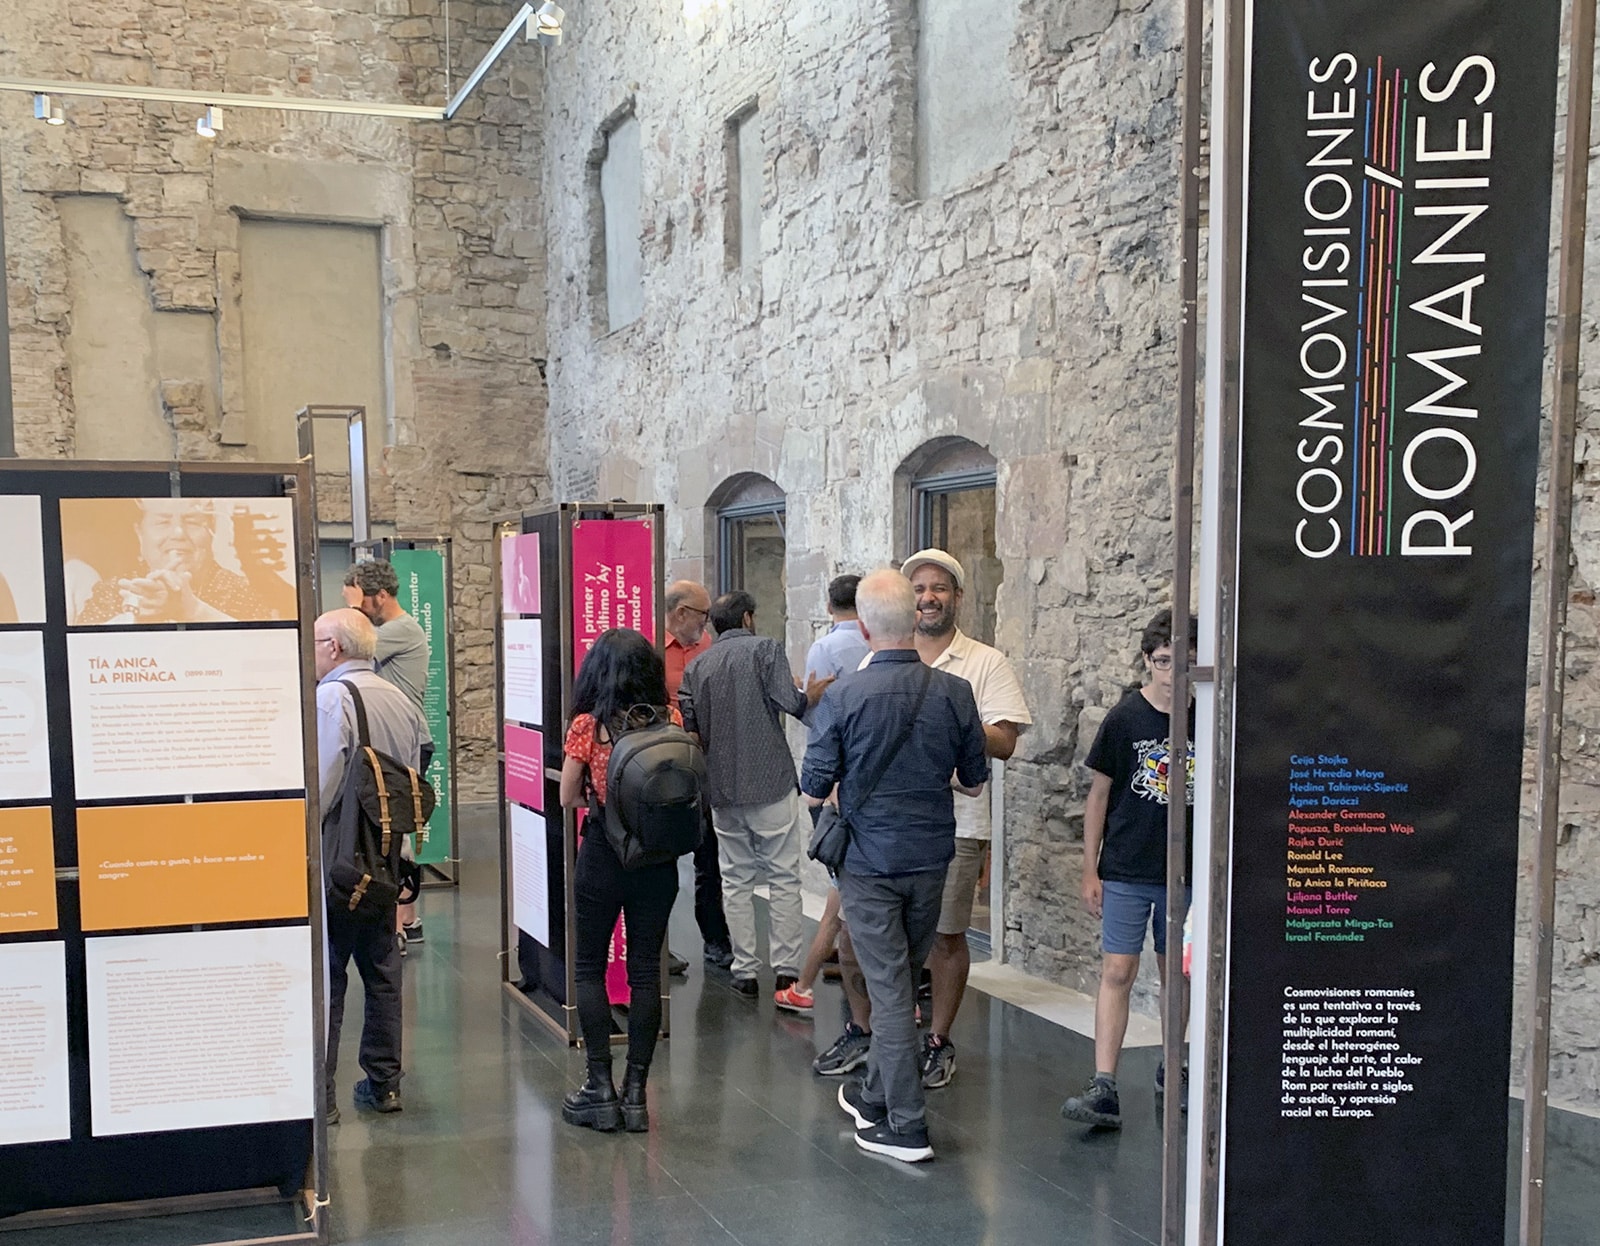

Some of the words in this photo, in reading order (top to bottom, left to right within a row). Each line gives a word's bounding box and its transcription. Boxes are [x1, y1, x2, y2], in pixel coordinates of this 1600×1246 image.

[1295, 52, 1358, 559] COSMOVISIONES
[585, 573, 595, 582] y
[616, 565, 627, 598] para
[583, 587, 597, 633] primer
[597, 589, 609, 631] último
[628, 586, 640, 630] madre
[616, 605, 625, 629] ron
[581, 639, 594, 650] el
[89, 656, 109, 669] TÍA
[114, 658, 157, 668] ANICA
[90, 673, 107, 683] LA
[113, 669, 176, 683] PIRIÑACA
[433, 760, 445, 770] el
[1290, 755, 1314, 766] Ceija
[1318, 755, 1348, 767] Stojka
[1289, 769, 1309, 780] José
[1313, 769, 1352, 779] Heredia
[1356, 770, 1384, 780] Maya
[431, 775, 445, 807] poder
[1289, 783, 1324, 792] Hedina
[1288, 810, 1337, 819] Alexander
[1340, 810, 1385, 819] Germano
[1390, 825, 1415, 835] Wajs
[1288, 838, 1315, 848] Rajko
[1287, 851, 1321, 860] Ronald
[1325, 852, 1343, 860] Lee
[1287, 864, 1325, 874] Manush
[1329, 865, 1374, 874] Romanov
[1304, 878, 1332, 887] Anica
[1335, 878, 1344, 887] la
[1347, 879, 1387, 888] Piriñaca
[1325, 892, 1358, 901] Buttler
[1286, 906, 1322, 914] Manuel
[1326, 906, 1350, 914] Torre
[1344, 919, 1393, 930] Mirga-Tas
[1286, 932, 1312, 941] Israel
[1315, 933, 1364, 942] Fernández
[1284, 987, 1361, 997] Cosmovisiones
[1364, 988, 1415, 997] romaníes
[1283, 1002, 1295, 1010] es
[1299, 1002, 1319, 1010] una
[1324, 1001, 1372, 1010] tentativa
[1375, 1002, 1383, 1010] a
[1388, 1001, 1421, 1011] través
[1283, 1013, 1297, 1023] de
[1301, 1013, 1311, 1023] la
[1315, 1016, 1335, 1025] que
[1339, 1013, 1384, 1025] explorar
[1388, 1013, 1398, 1023] la
[1283, 1027, 1352, 1039] multiplicidad
[1356, 1028, 1396, 1038] romaní,
[1283, 1040, 1314, 1050] desde
[1318, 1040, 1328, 1050] el
[1332, 1040, 1399, 1052] heterogéneo
[1282, 1053, 1328, 1065] lenguaje
[1332, 1053, 1348, 1063] del
[1352, 1055, 1377, 1064] arte,
[1380, 1053, 1391, 1064] al
[1394, 1054, 1422, 1064] calor
[1282, 1067, 1296, 1077] de
[1300, 1067, 1310, 1077] la
[1314, 1066, 1342, 1077] lucha
[1346, 1067, 1362, 1077] del
[1367, 1067, 1404, 1078] Pueblo
[1282, 1080, 1306, 1090] Rom
[1310, 1082, 1329, 1092] por
[1332, 1081, 1367, 1090] resistir
[1371, 1082, 1378, 1091] a
[1382, 1080, 1413, 1093] siglos
[1281, 1093, 1295, 1103] de
[1299, 1093, 1336, 1104] asedio,
[1340, 1096, 1346, 1105] y
[1350, 1095, 1396, 1105] opresión
[1281, 1107, 1311, 1117] racial
[1315, 1109, 1328, 1117] en
[1332, 1107, 1373, 1118] Europa.
